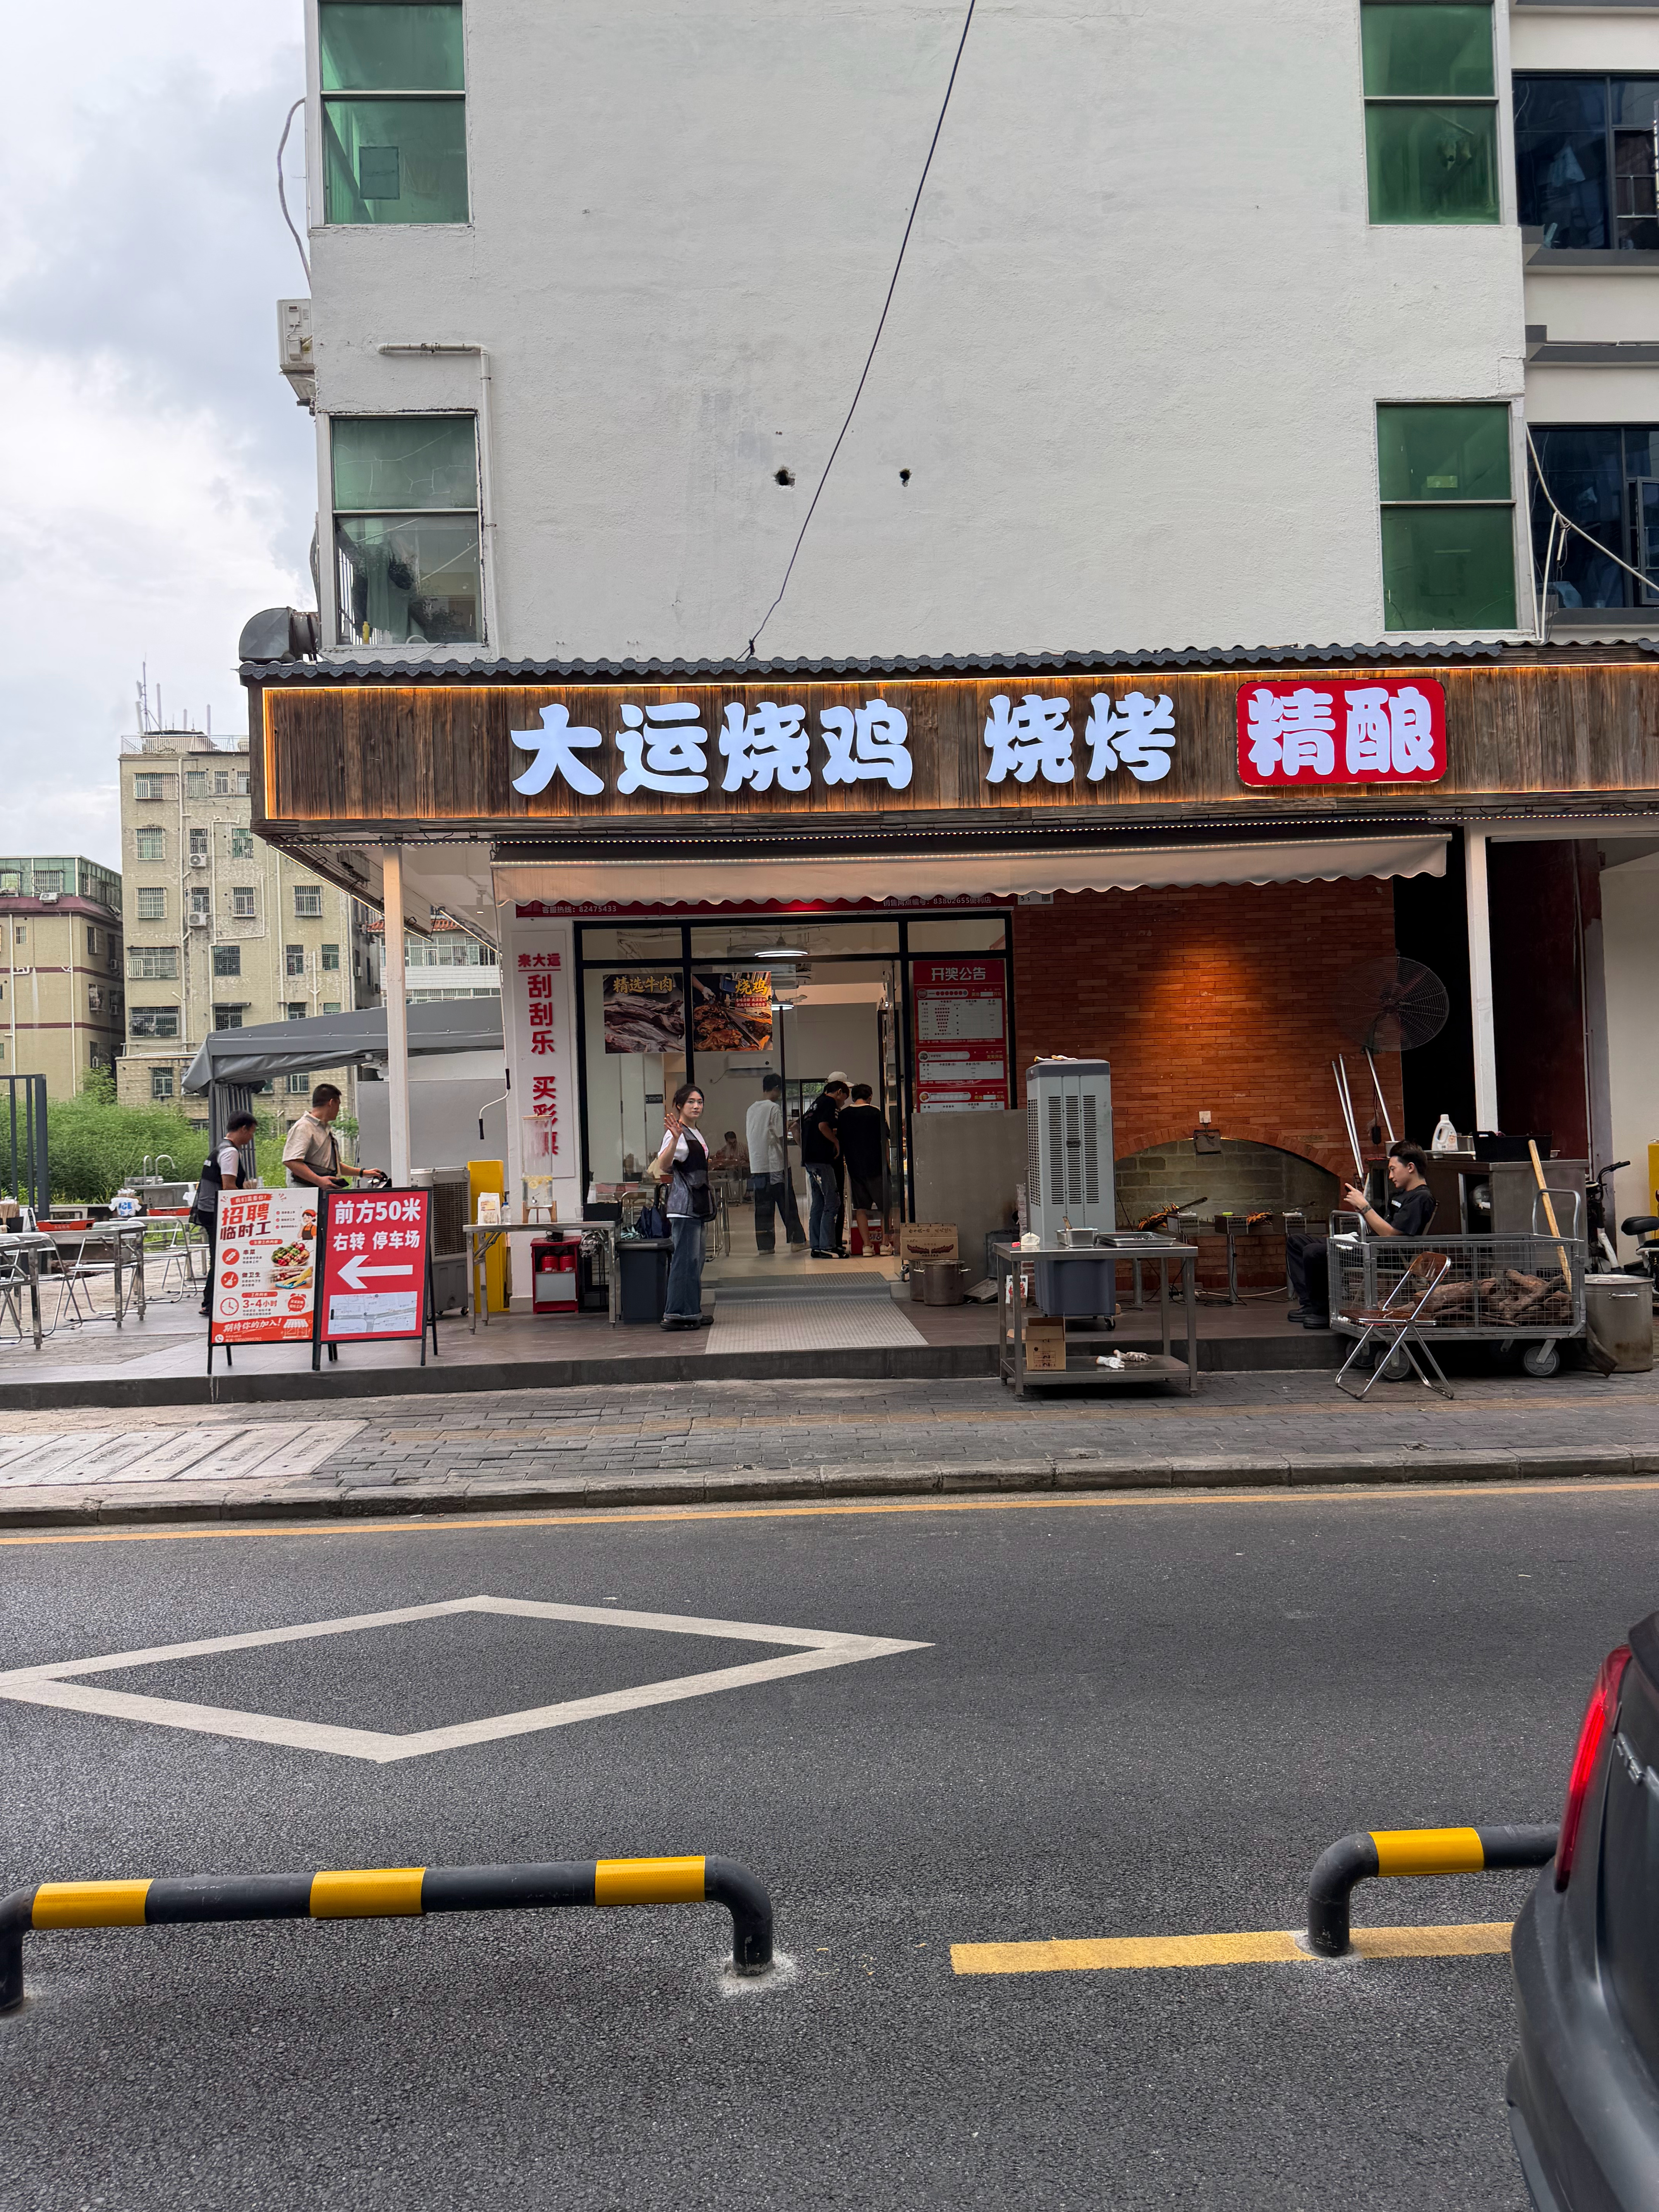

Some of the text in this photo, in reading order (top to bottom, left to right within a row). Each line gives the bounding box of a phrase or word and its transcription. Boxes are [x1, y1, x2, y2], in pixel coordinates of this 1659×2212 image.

[1248, 686, 1435, 776] 精酿
[511, 691, 1175, 795] 大运烧鸡 烧烤
[518, 953, 561, 967] 来大运
[931, 967, 986, 981] 开奖公告
[613, 976, 673, 994] 精选牛肉
[735, 977, 768, 996] 烧鸡
[527, 974, 555, 1055] 刮刮乐
[222, 1203, 270, 1226] 招聘
[335, 1198, 421, 1224] 前方50米
[220, 1221, 271, 1240] 临时工
[333, 1230, 420, 1251] 右转 停车场
[243, 1299, 277, 1308] 3-4小时
[223, 1318, 282, 1333] 期待你的加入!
